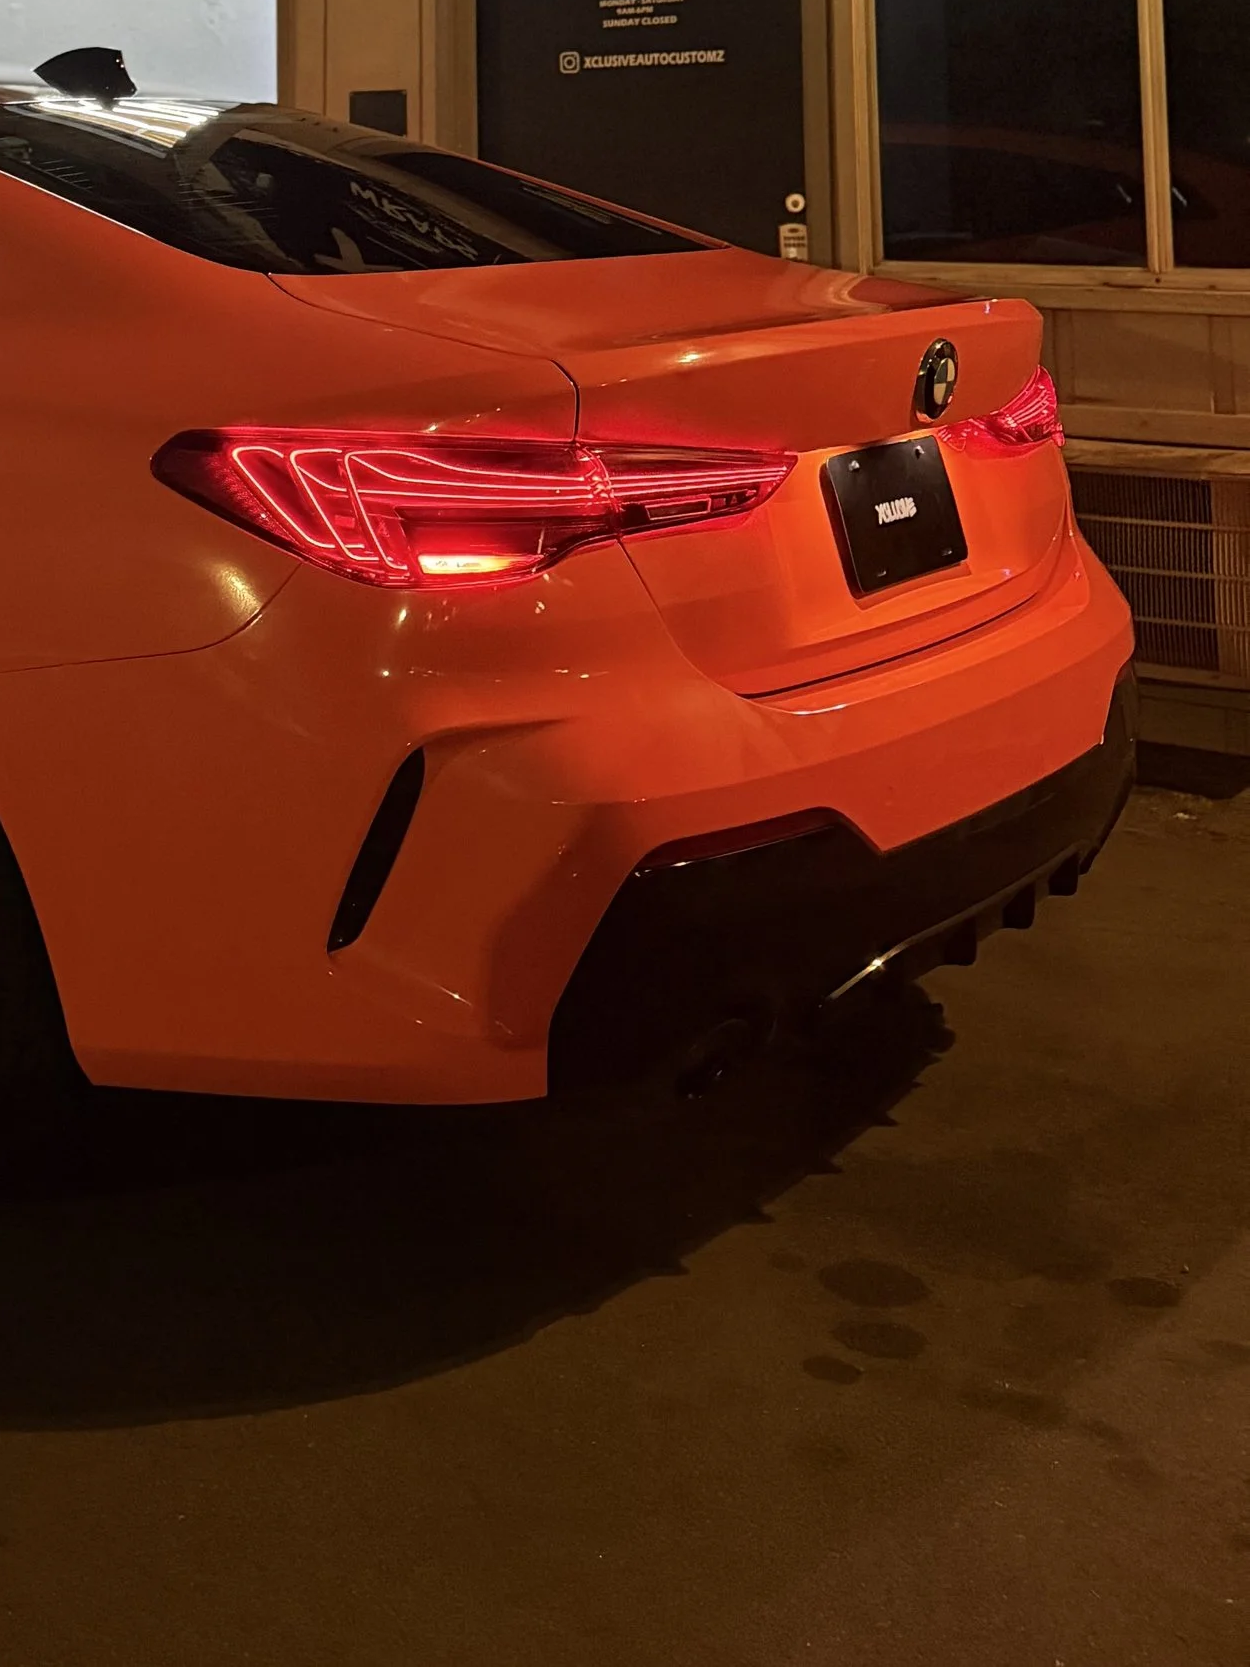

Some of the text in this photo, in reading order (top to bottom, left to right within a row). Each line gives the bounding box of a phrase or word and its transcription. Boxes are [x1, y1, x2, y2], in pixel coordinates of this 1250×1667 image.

[602, 15, 678, 29] SUNDAY CLOSED
[583, 50, 725, 69] XCLUSIVEAUTOCUSTOMZ
